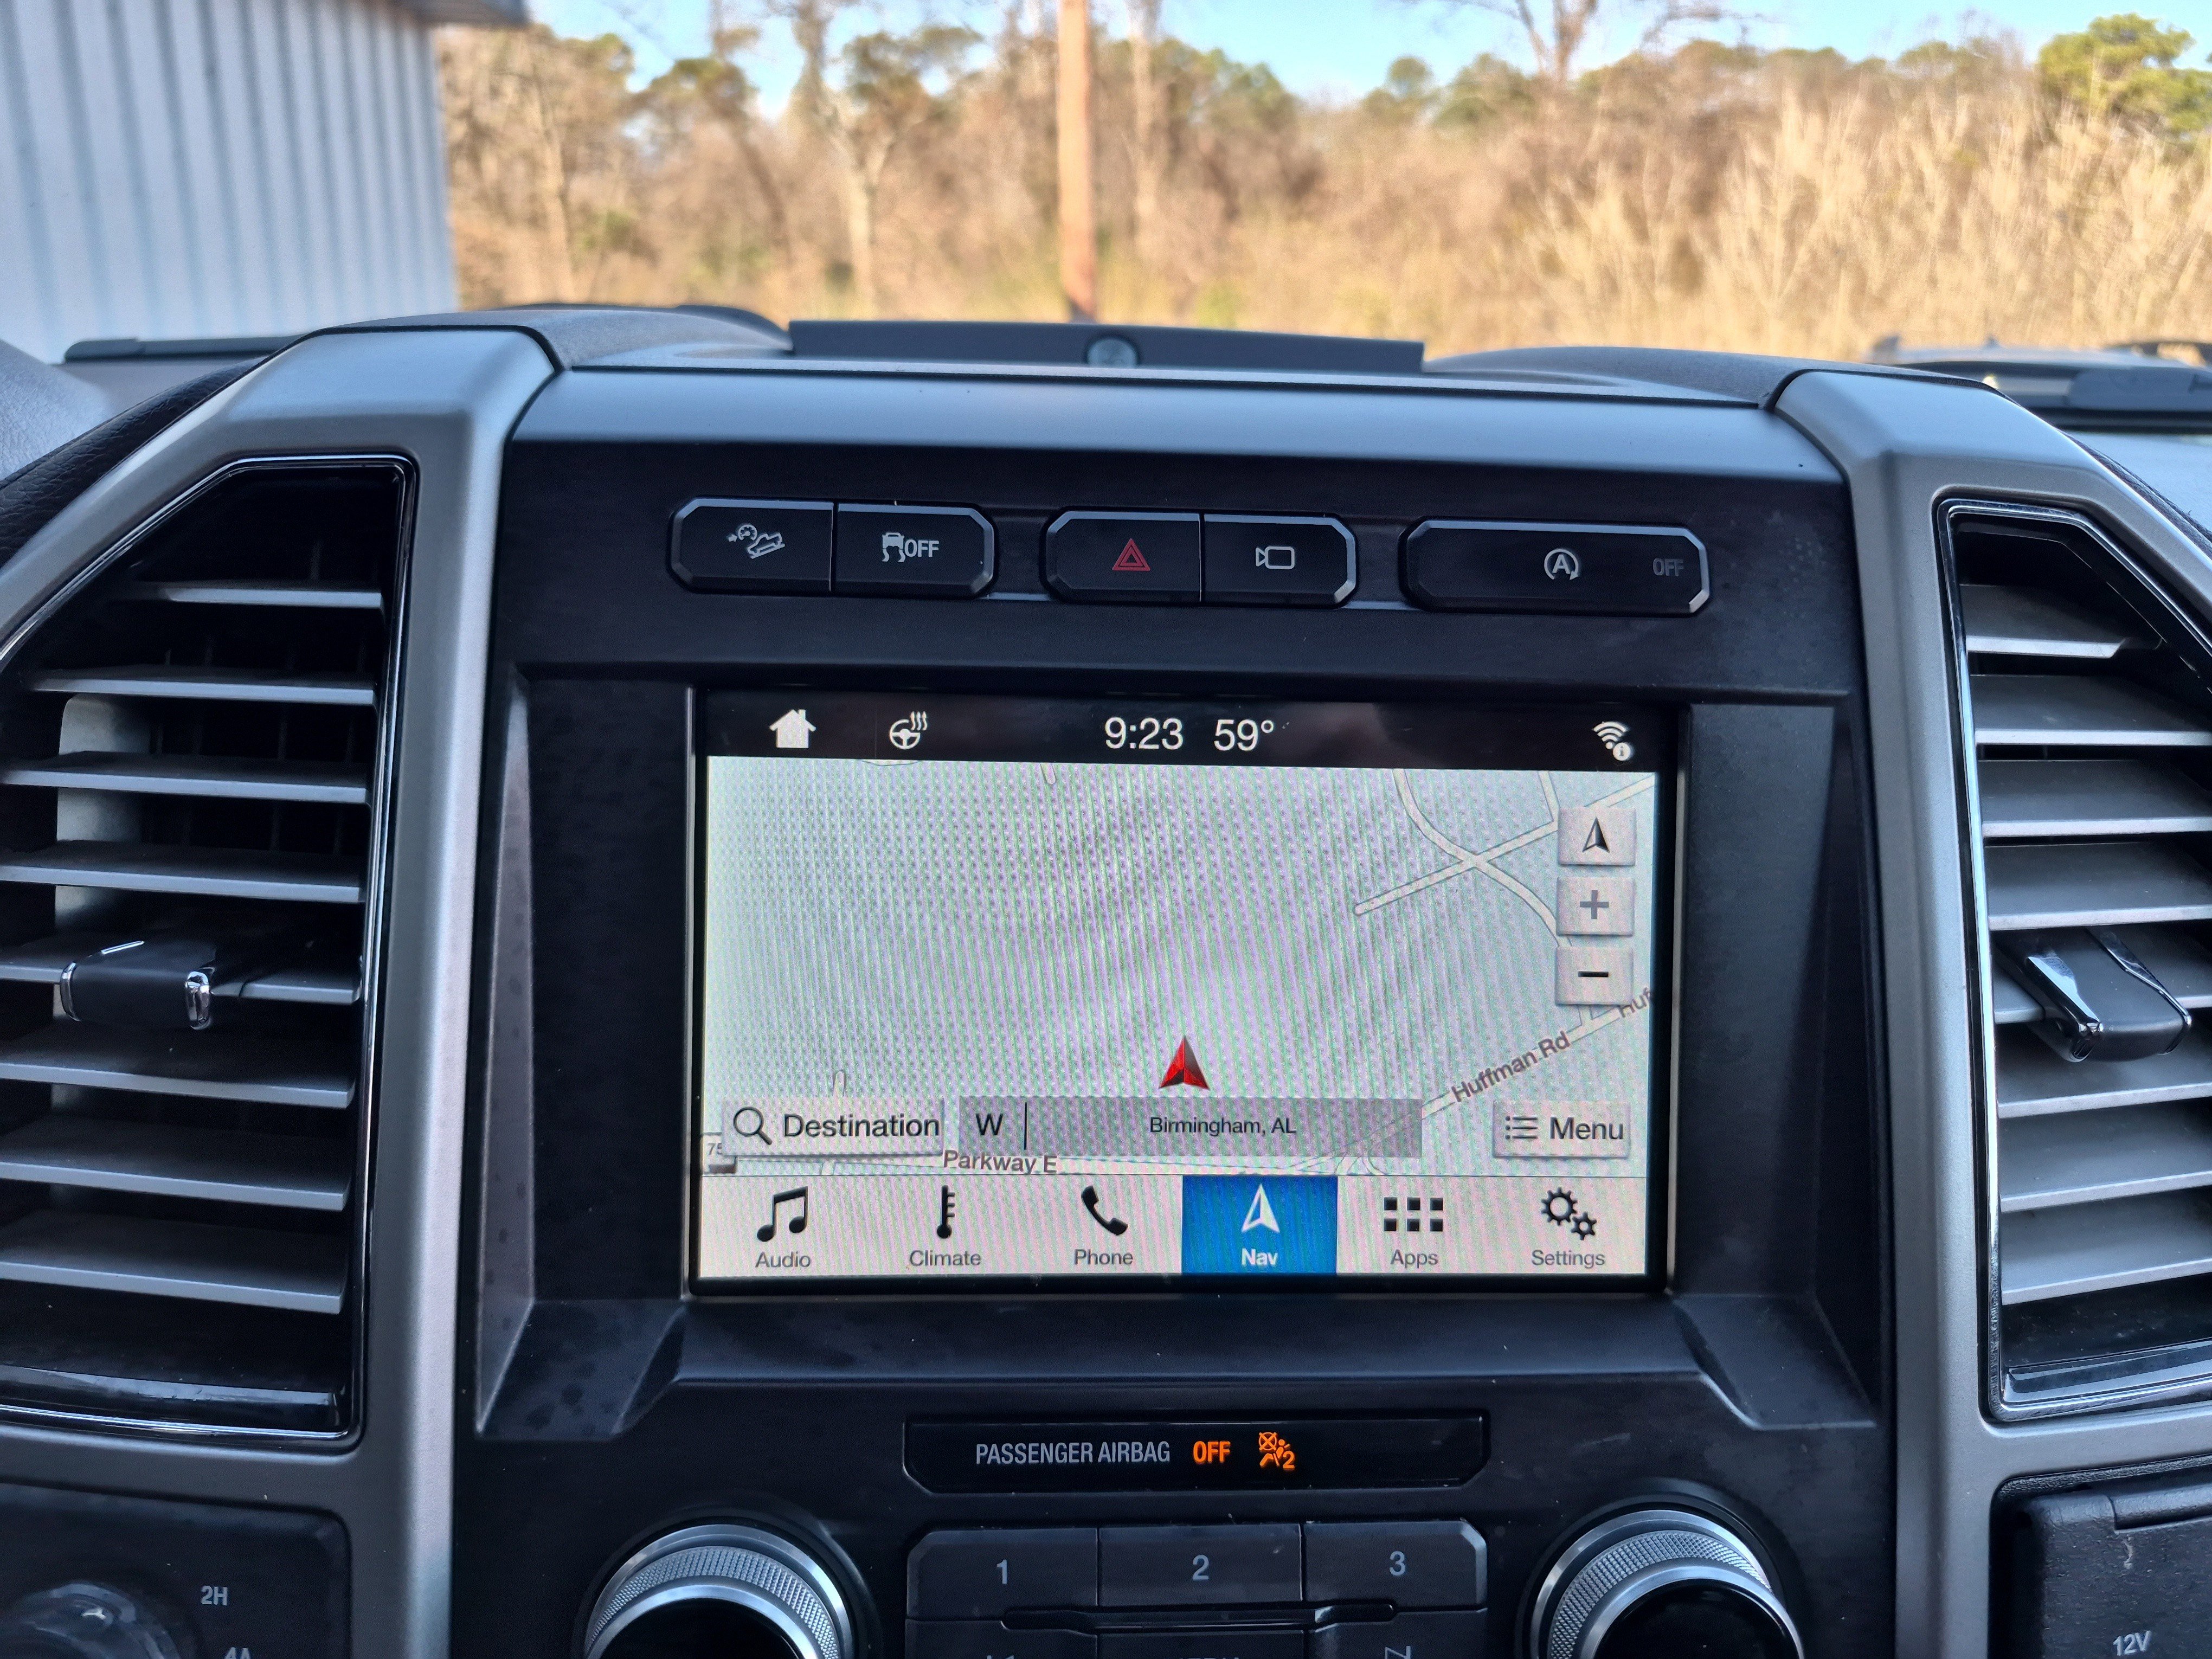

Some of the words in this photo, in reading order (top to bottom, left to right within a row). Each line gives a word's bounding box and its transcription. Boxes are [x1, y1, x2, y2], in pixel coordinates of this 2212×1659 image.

[904, 539, 939, 557] OFF
[1652, 558, 1684, 577] OFF
[1104, 717, 1184, 750] 9:23
[1451, 1052, 1538, 1103] Huffman
[1538, 1031, 1571, 1059] Rd
[783, 1113, 940, 1137] Destination
[975, 1113, 1004, 1136] W
[1150, 1117, 1265, 1136] Birmingham,
[1271, 1118, 1296, 1134] AL
[1549, 1116, 1624, 1140] Menu
[943, 1149, 1036, 1174] Parkway
[1044, 1155, 1057, 1173] E
[755, 1251, 811, 1268] Audio
[909, 1250, 982, 1266] Climate
[1074, 1249, 1133, 1265] Phone
[1242, 1249, 1278, 1266] Nav
[1390, 1249, 1438, 1269] Apps
[1532, 1249, 1605, 1269] Settings
[975, 1442, 1092, 1464] PASSENGER
[1097, 1441, 1170, 1462] AIRBAG
[1193, 1441, 1231, 1463] OFF
[997, 1560, 1008, 1585] 1
[1193, 1555, 1210, 1580] 2
[1389, 1551, 1406, 1577] 3
[201, 1585, 228, 1606] 2H
[2113, 1630, 2151, 1656] 12V
